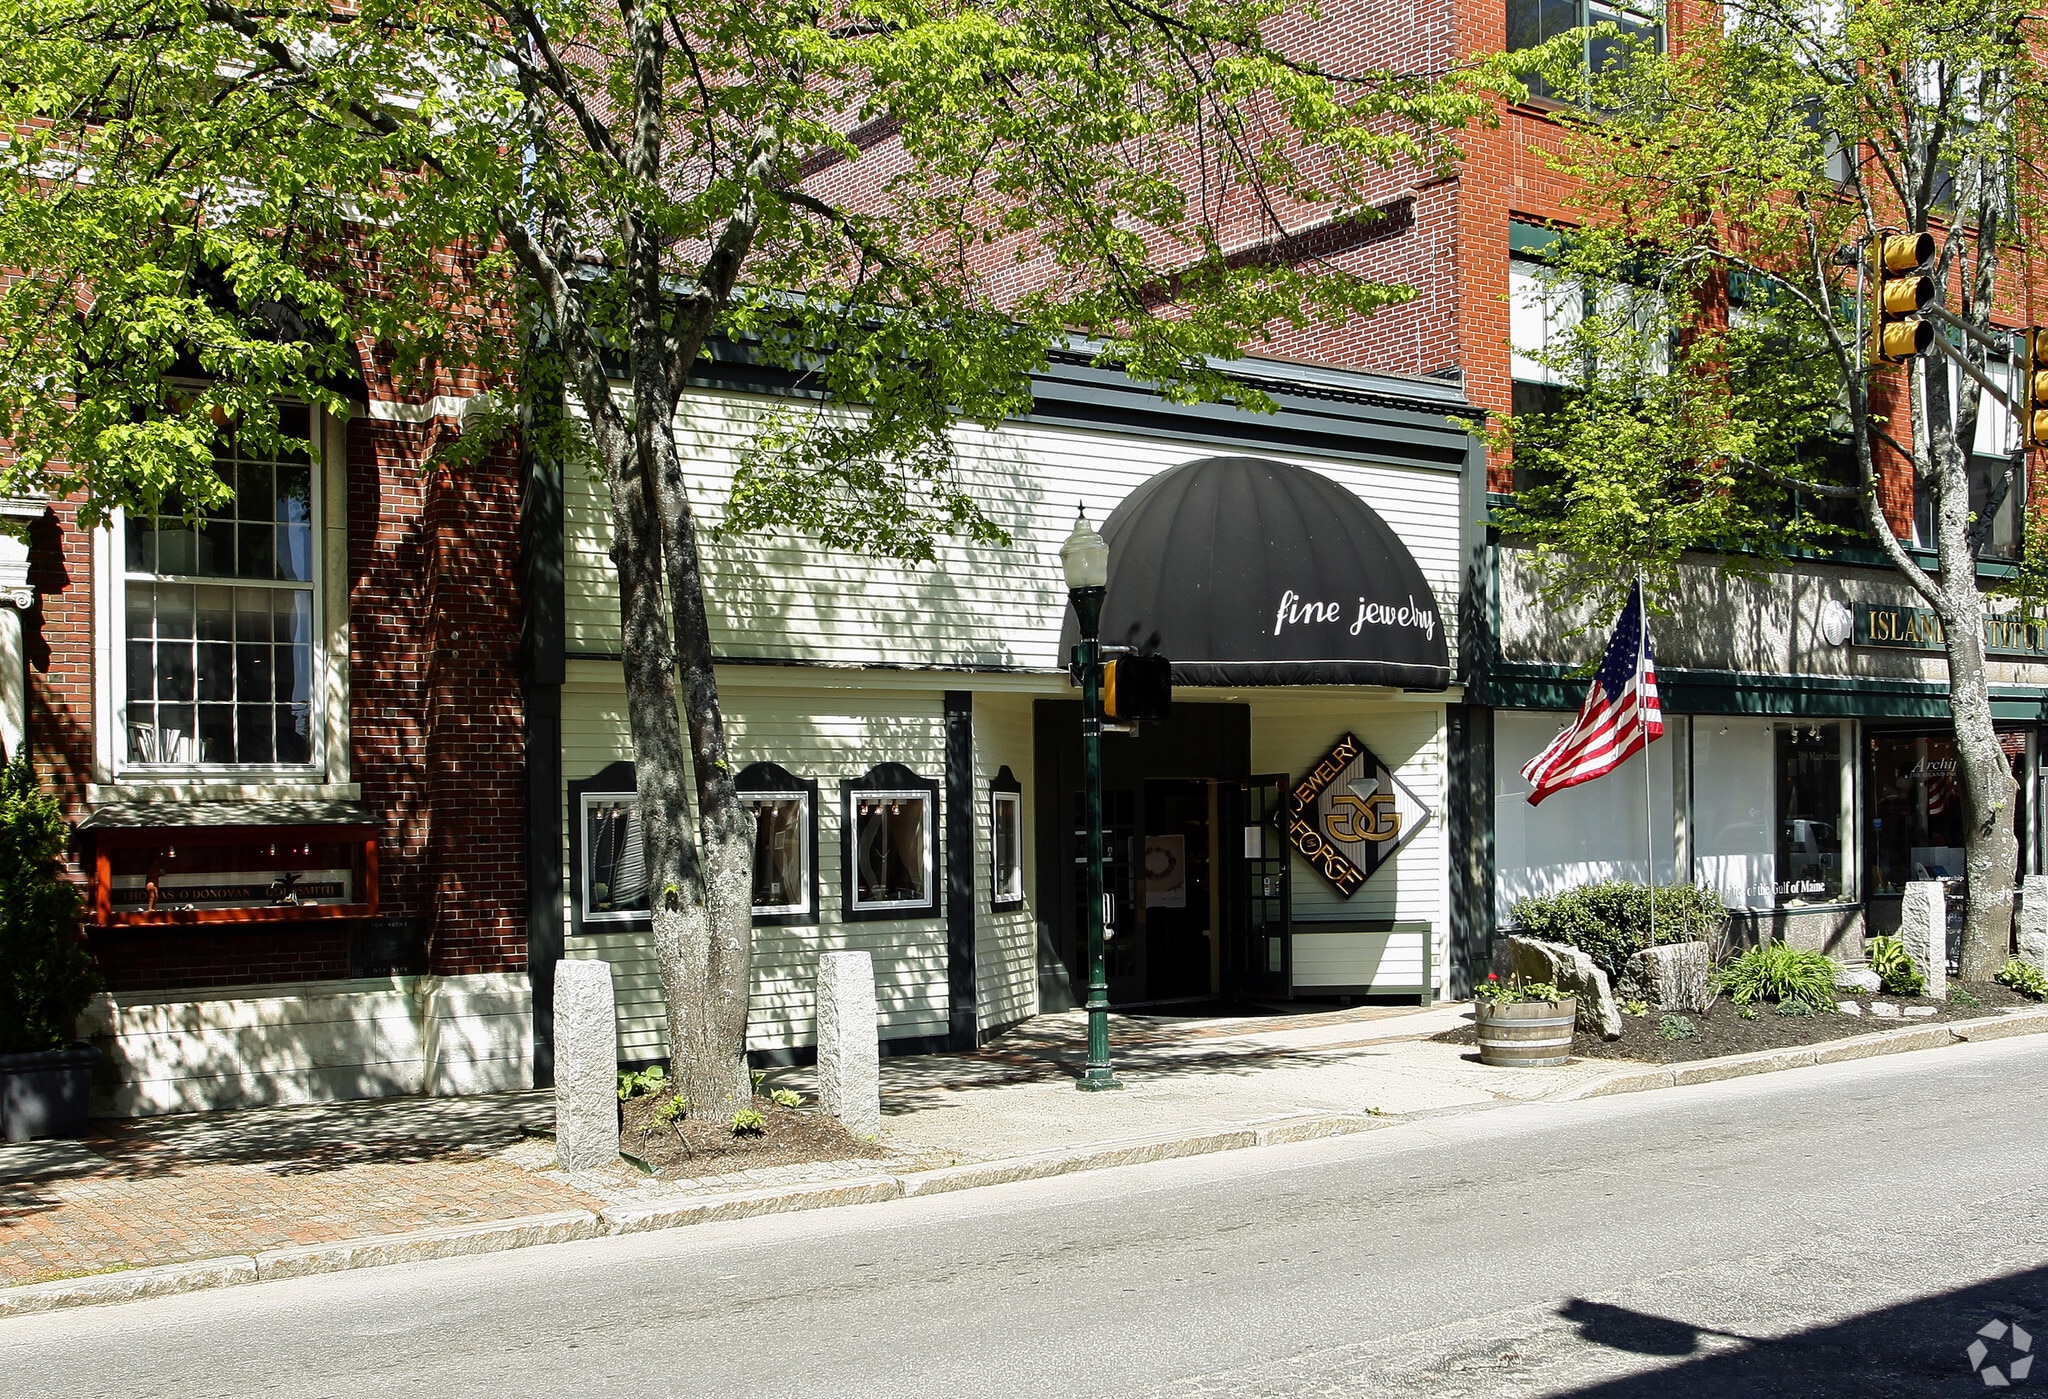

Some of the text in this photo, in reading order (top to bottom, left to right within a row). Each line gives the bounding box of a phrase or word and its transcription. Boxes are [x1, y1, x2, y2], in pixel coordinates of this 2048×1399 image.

[1274, 590, 1435, 641] fine jewelry
[1293, 736, 1358, 812] JEWELRY
[121, 884, 335, 902] THOAS O'DONOVAN GOLSMITH
[1771, 881, 1791, 896] Gulf
[1790, 880, 1801, 894] of
[1800, 879, 1826, 893] Maine
[372, 966, 408, 975] DEPSITS
